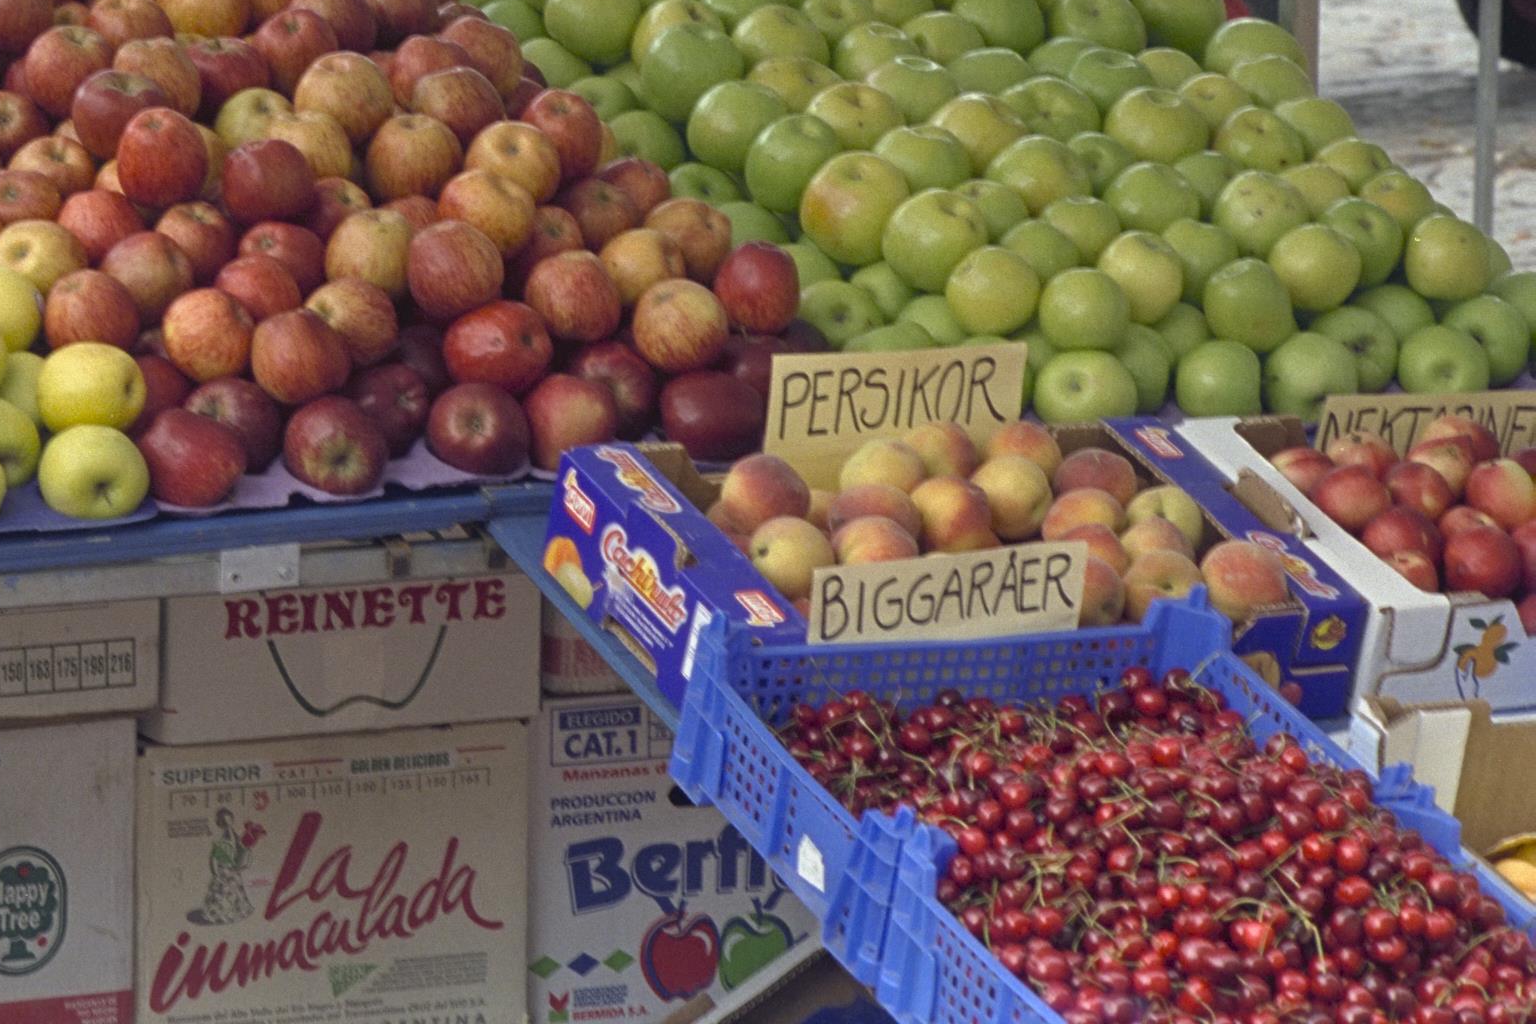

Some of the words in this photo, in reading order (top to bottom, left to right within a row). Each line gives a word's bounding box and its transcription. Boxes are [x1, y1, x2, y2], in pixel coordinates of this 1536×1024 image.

[779, 355, 1007, 440] PERSIKOR
[1321, 404, 1536, 458] NKTNE
[223, 578, 507, 640] REINETTE
[2, 662, 22, 682] 150
[56, 656, 77, 677] 175
[111, 651, 132, 673] 216
[162, 764, 261, 786] SUPERIOR
[550, 789, 657, 811] PRODUCCION
[550, 809, 642, 827] ARGENTINA
[264, 810, 357, 920] La
